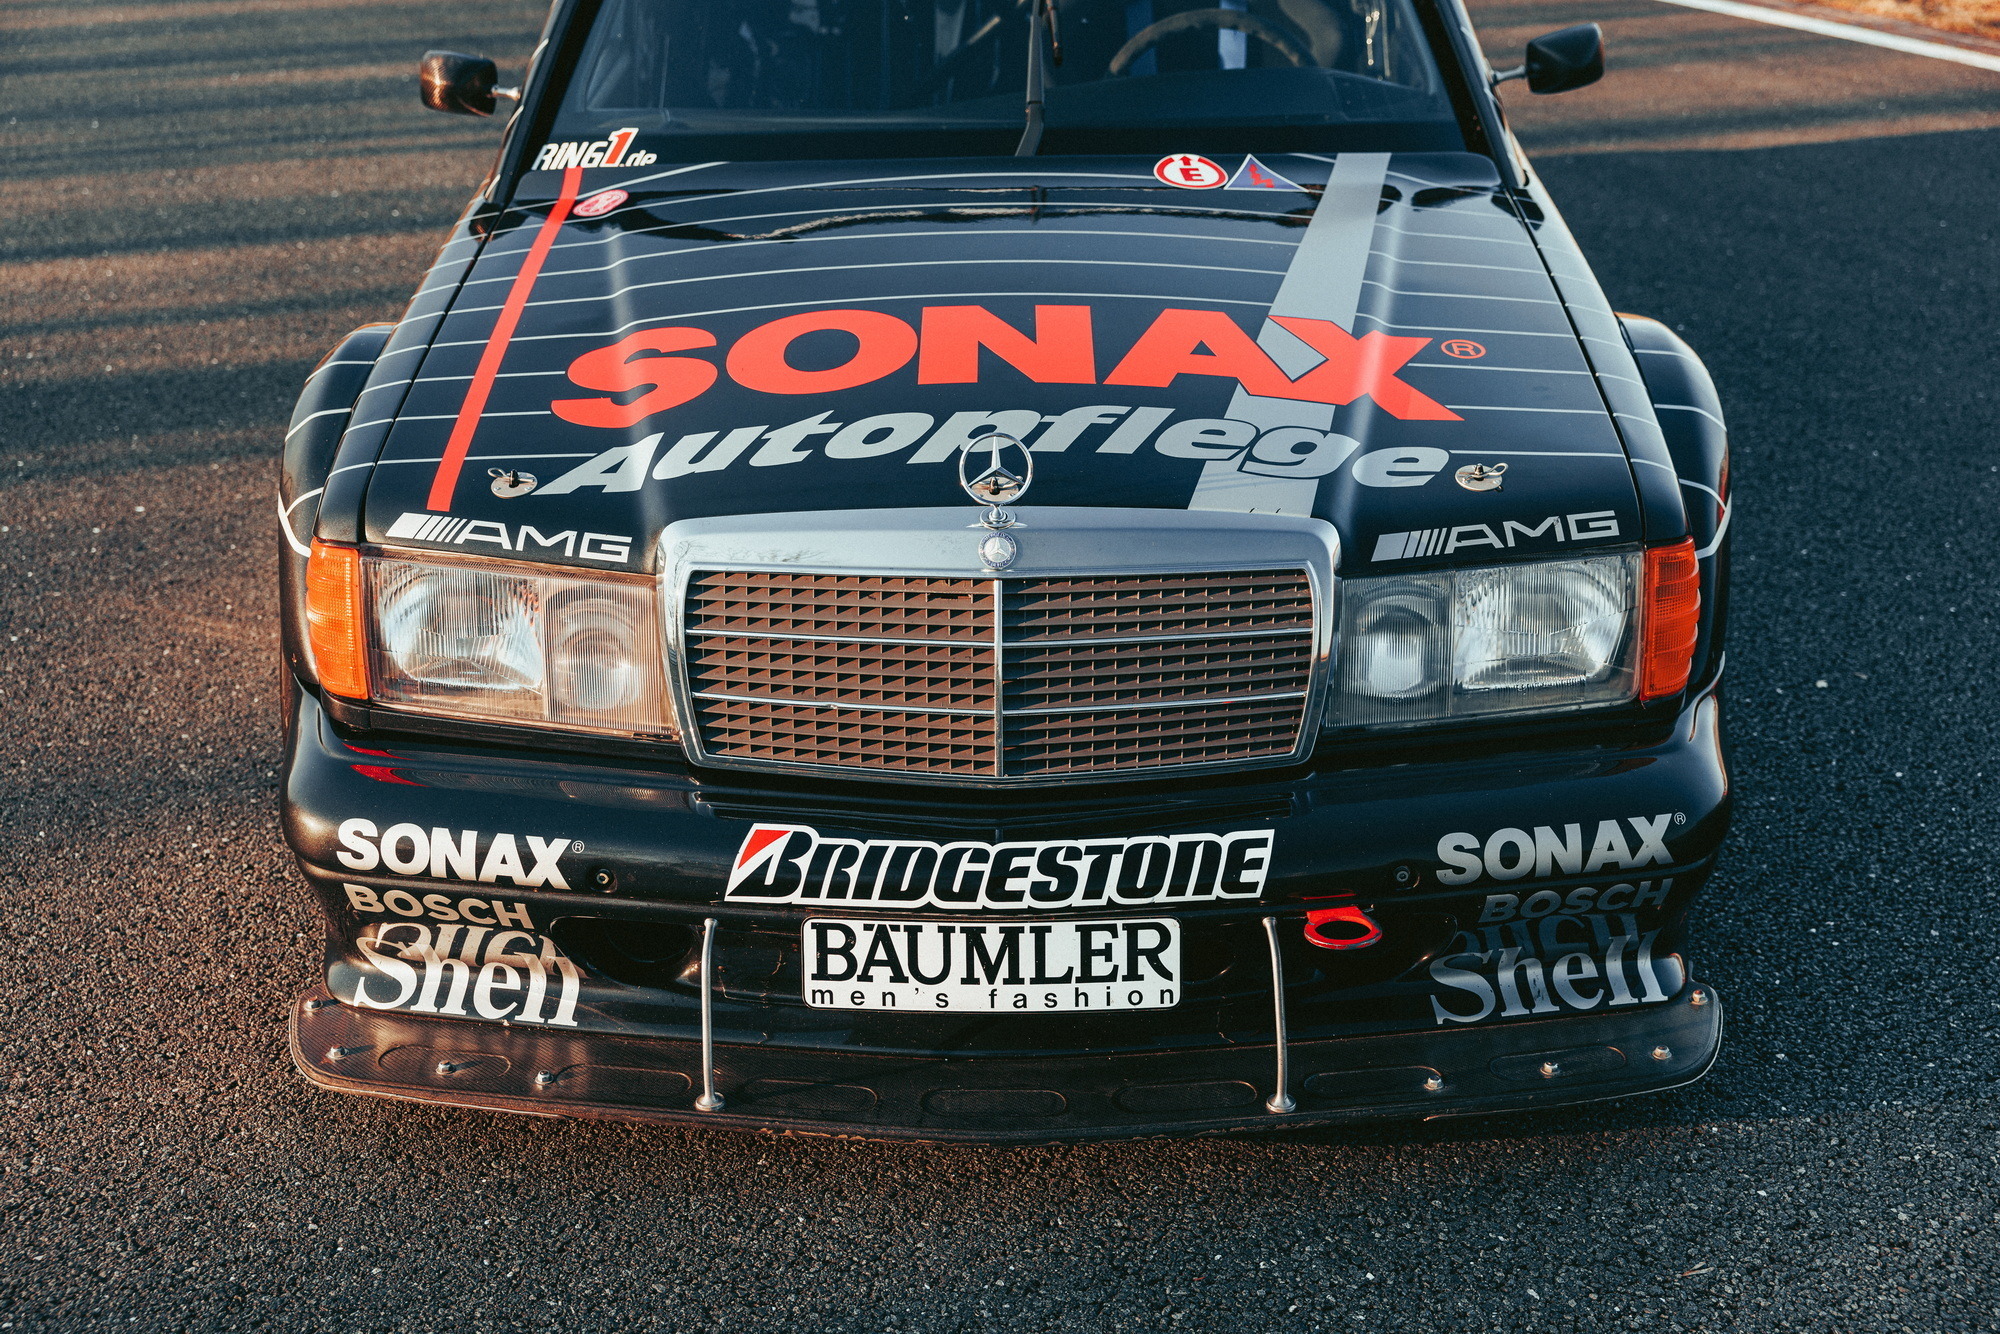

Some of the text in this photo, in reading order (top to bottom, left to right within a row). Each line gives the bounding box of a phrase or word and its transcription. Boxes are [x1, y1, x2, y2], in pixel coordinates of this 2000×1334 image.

[531, 405, 1450, 495] Autopflege
[724, 823, 1275, 909] BRIDGESTONE
[1478, 878, 1674, 923] BOSCH
[343, 883, 534, 929] BOSCH
[353, 935, 580, 1027] Shell
[810, 921, 1174, 986] BÄUMLER
[1429, 927, 1663, 1025] Shell
[988, 986, 1175, 1009] fashion
